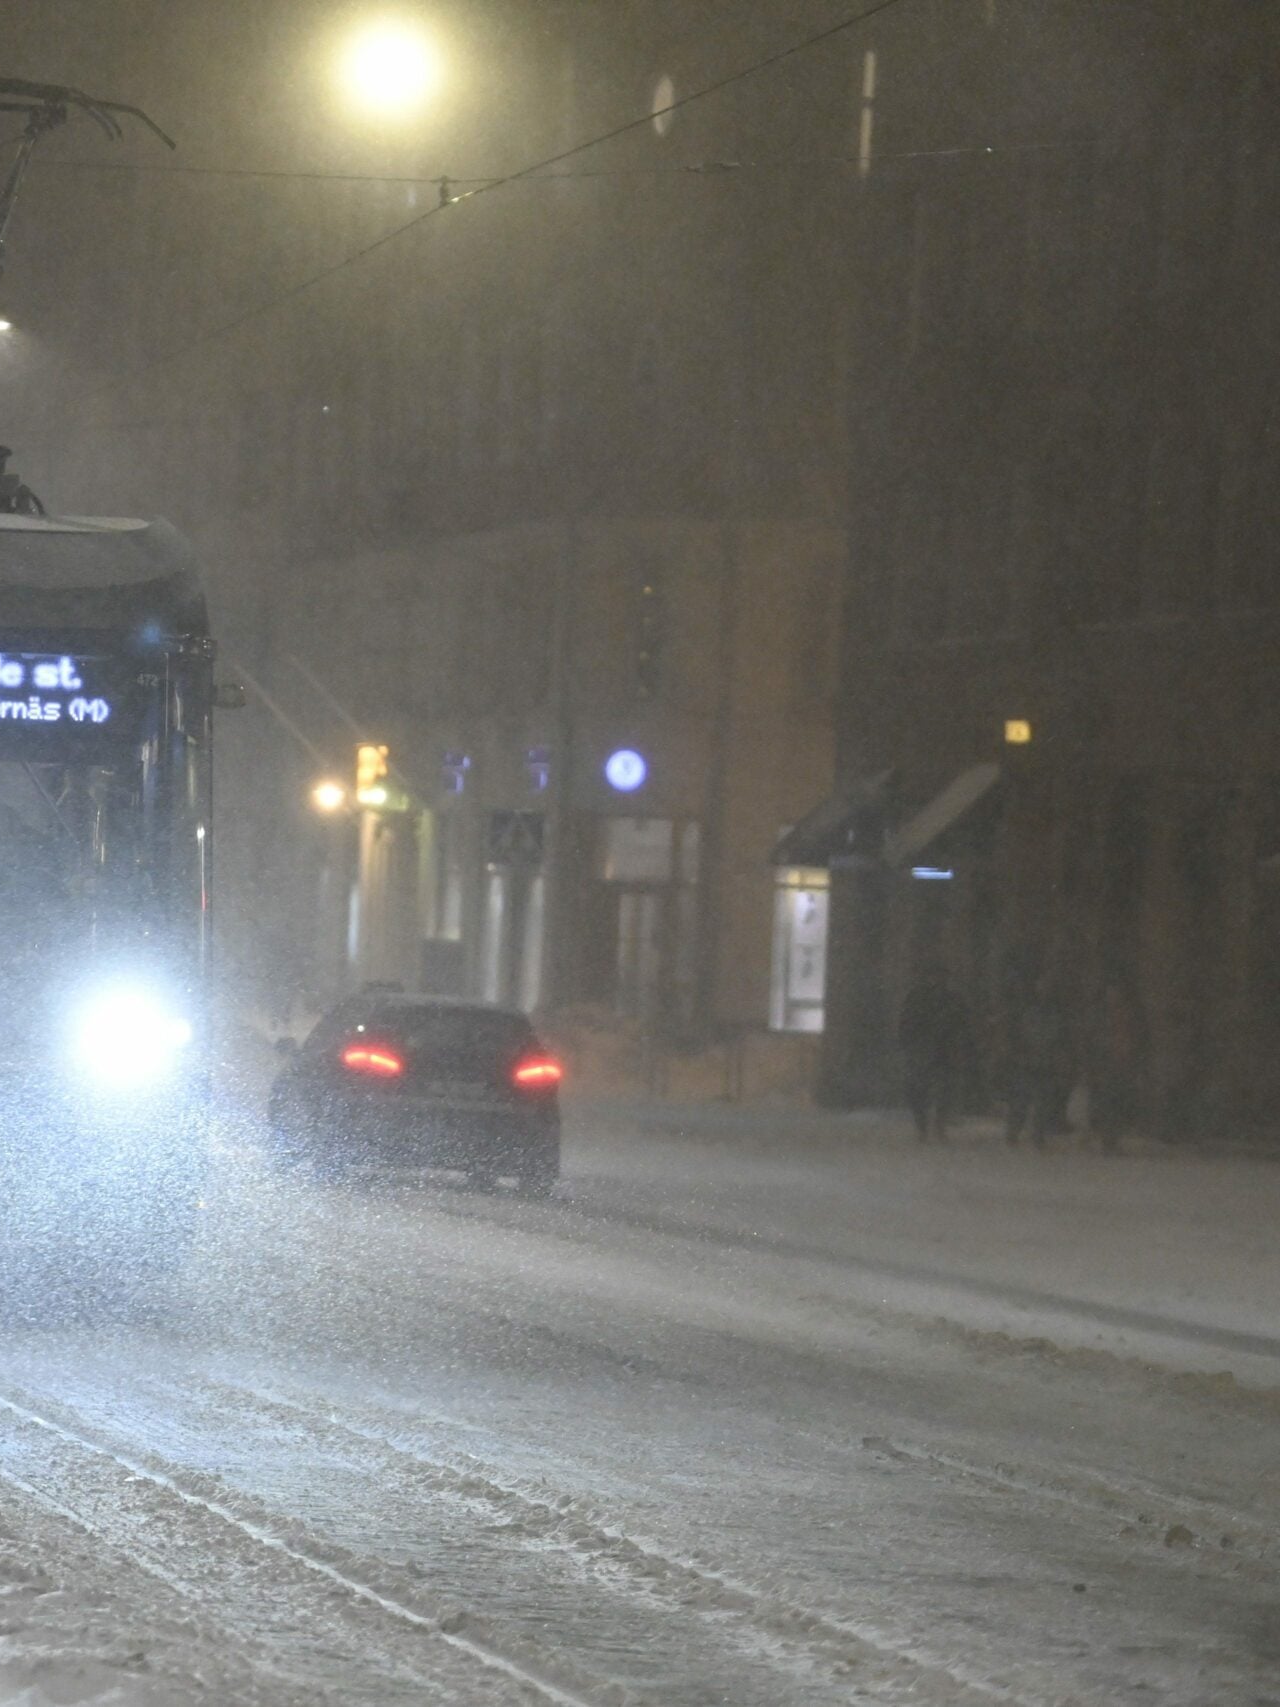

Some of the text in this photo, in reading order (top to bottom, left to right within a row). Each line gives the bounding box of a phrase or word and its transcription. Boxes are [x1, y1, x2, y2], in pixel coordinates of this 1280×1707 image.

[33, 655, 83, 690] st.
[136, 673, 159, 687] 472
[68, 697, 111, 723] (M)
